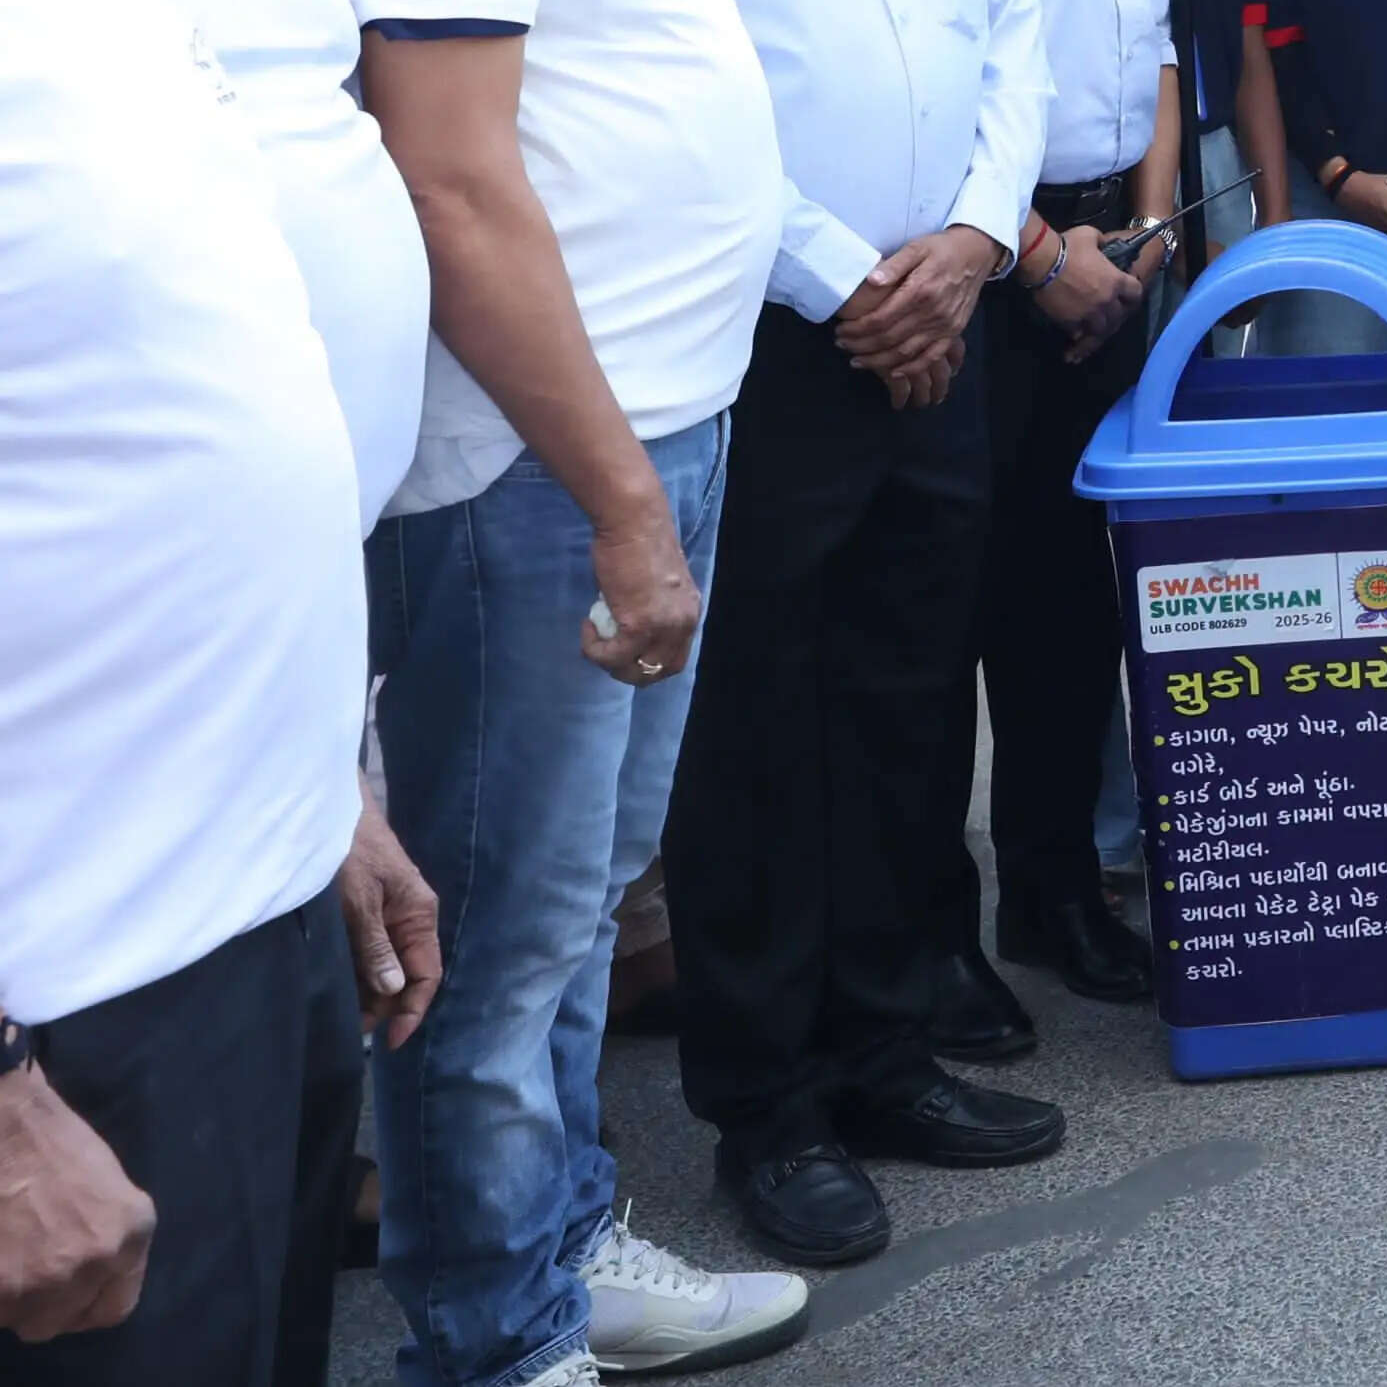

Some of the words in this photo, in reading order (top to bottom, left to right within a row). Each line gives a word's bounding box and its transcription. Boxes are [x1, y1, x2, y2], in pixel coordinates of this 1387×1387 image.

[1147, 573, 1260, 599] SWACHH
[1149, 589, 1323, 619] SURVEKSHAN
[1150, 622, 1172, 635] ULB
[1175, 620, 1205, 633] CODE
[1208, 617, 1248, 630] 802629
[1274, 612, 1333, 629] 2025-26
[1166, 654, 1261, 716] સુકો
[1169, 728, 1236, 748] કાગળ,
[1299, 714, 1345, 737] પેપર,
[1171, 752, 1225, 776] વગેરે,
[1173, 782, 1210, 807] કાર્ડ
[1219, 777, 1257, 802] બોર્ડ
[1266, 773, 1305, 797] અને
[1276, 801, 1334, 826] કામમાં
[1176, 839, 1270, 865] મટીરીયલ.
[1181, 902, 1247, 923] આવતા
[1256, 894, 1299, 916] પેકેટ
[1350, 887, 1379, 909] પેક
[1184, 932, 1235, 953] તમામ
[1244, 921, 1315, 948] પ્રકારનો
[1186, 956, 1243, 981] કચરો.
